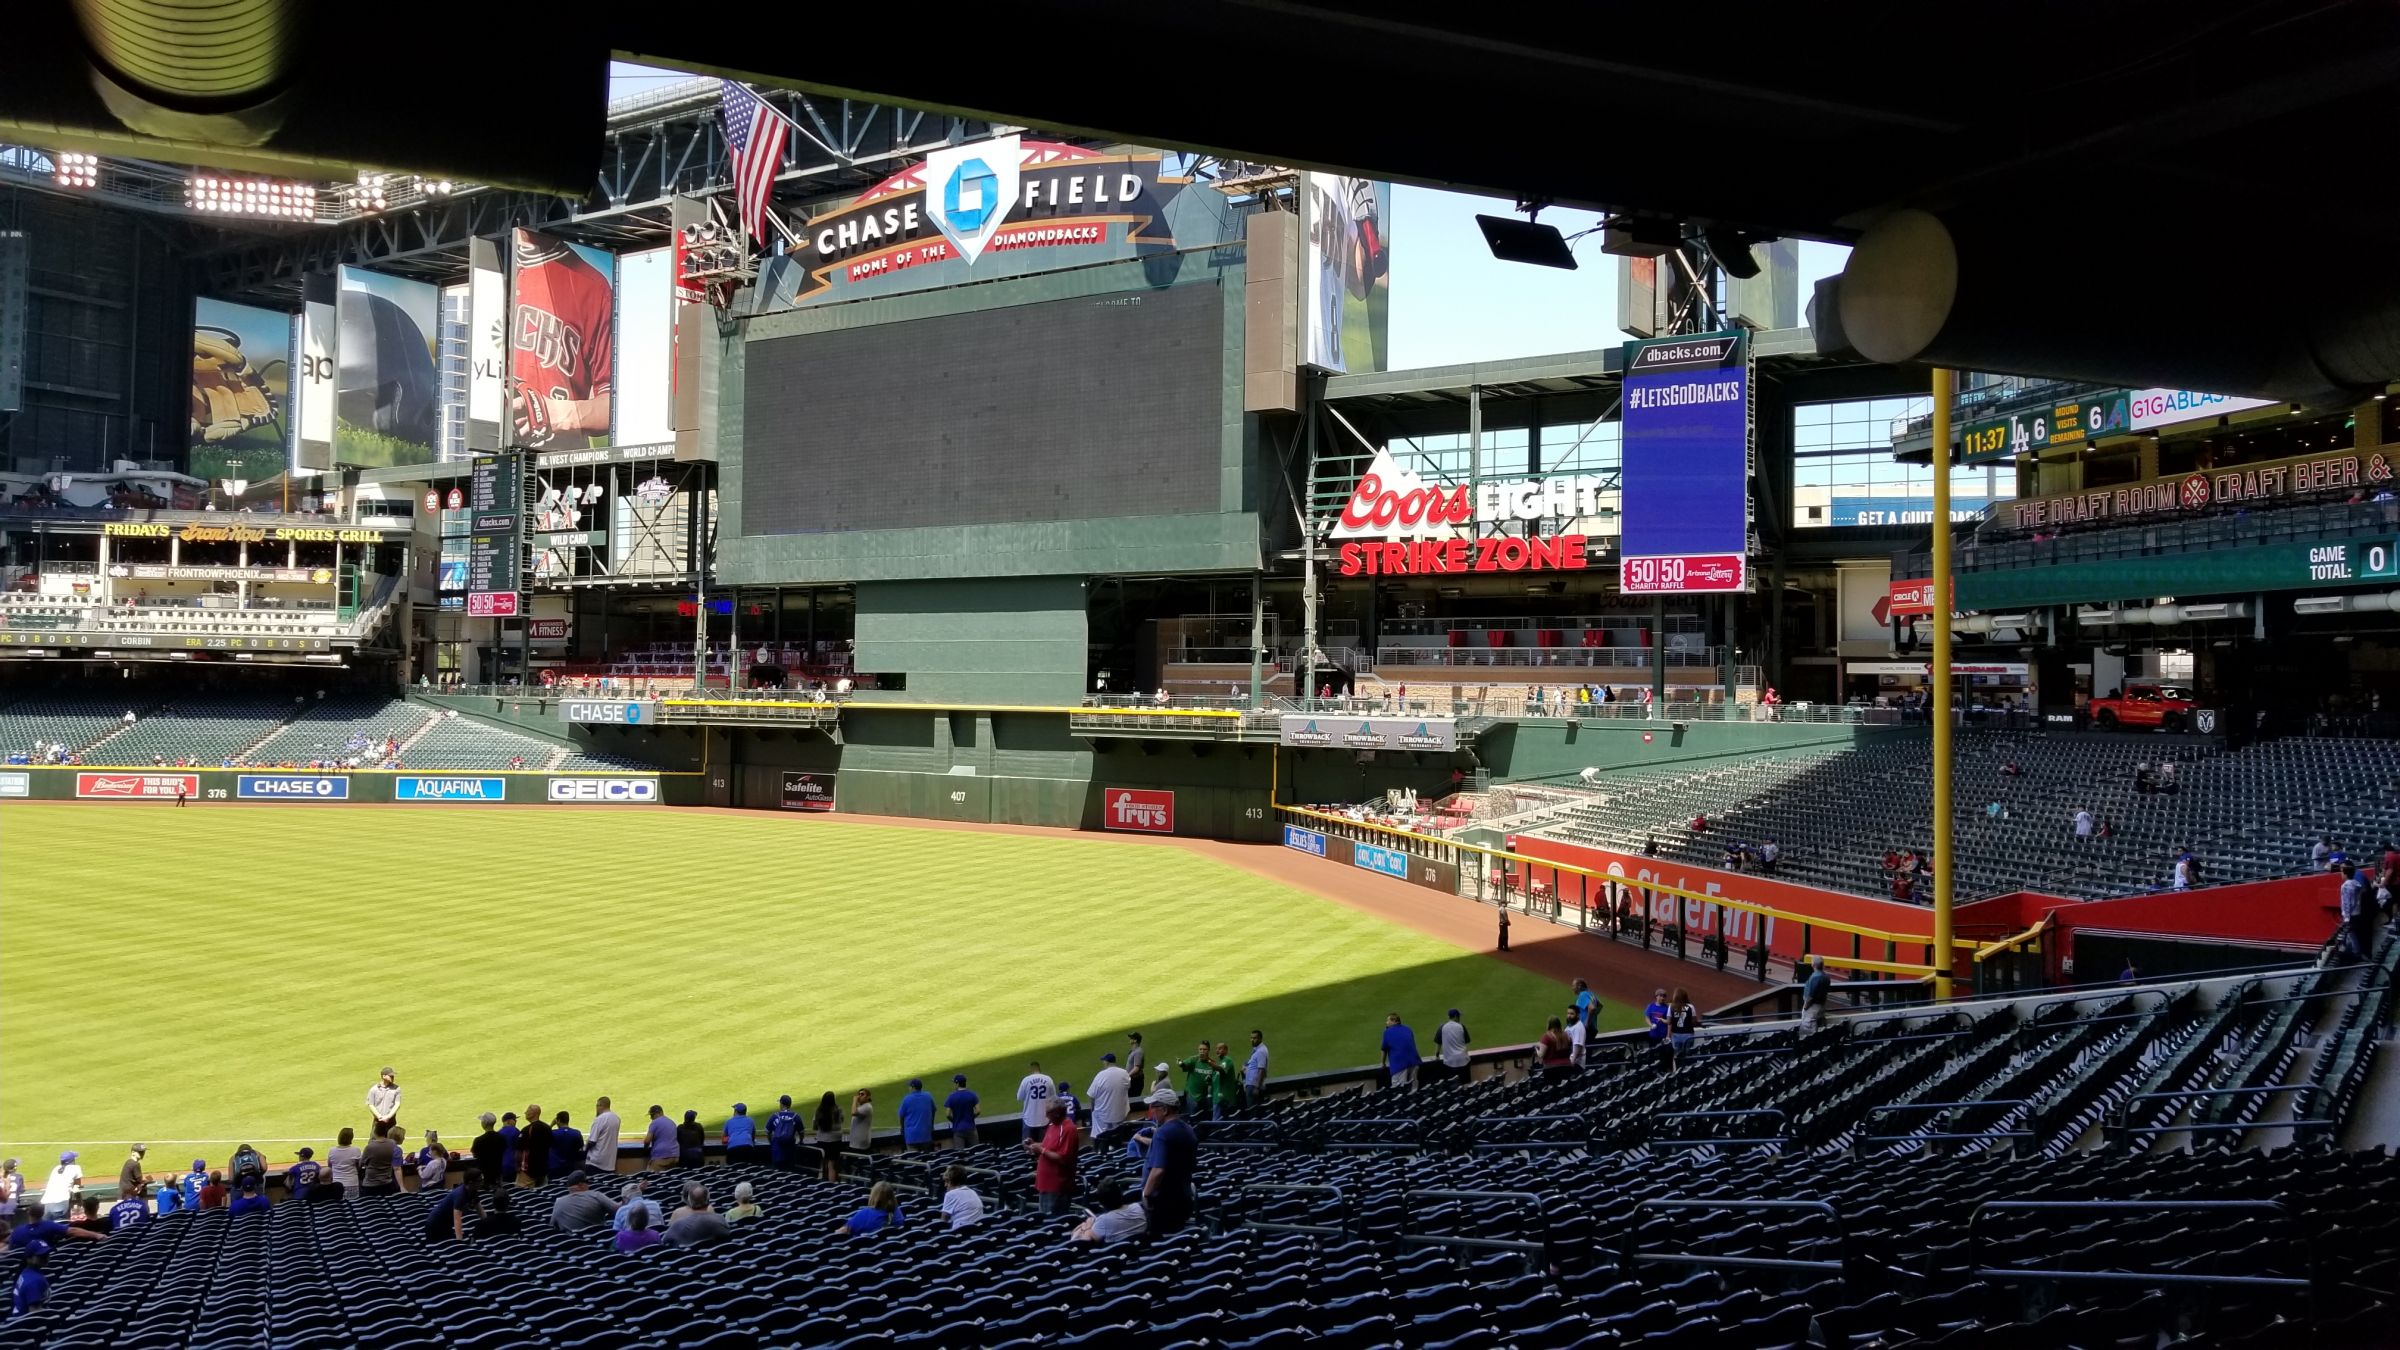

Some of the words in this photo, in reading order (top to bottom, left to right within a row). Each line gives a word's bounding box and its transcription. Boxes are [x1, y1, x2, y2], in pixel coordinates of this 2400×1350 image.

[817, 203, 919, 256] CHASE
[1024, 173, 1144, 209] FIELD
[853, 259, 889, 278] HOME
[896, 251, 912, 266] OF
[921, 244, 946, 259] THE
[994, 226, 1099, 247] DIAMONDBACKS
[1647, 345, 1721, 362] dbacks.com
[1629, 381, 1739, 409] #LETSGODBACKS
[2055, 404, 2079, 418] MOUND
[2132, 390, 2233, 418] G1GABLAS
[2056, 418, 2078, 430] VISITS
[2090, 405, 2102, 430] 6
[1965, 426, 2006, 455] 11:37
[2010, 415, 2029, 453] LA
[2034, 418, 2045, 441] 6
[2050, 429, 2085, 444] REMAINING
[539, 455, 548, 466] NL
[550, 453, 568, 465] WEST
[569, 450, 609, 463] CHAMPIONS
[623, 446, 647, 459] WORLD
[2013, 500, 2047, 528] THE
[2051, 492, 2112, 524] DRAFT
[2116, 483, 2176, 515] ROOM
[2215, 466, 2288, 504] CRAFT
[2294, 456, 2359, 493] BEER
[1341, 473, 1473, 529] Coors
[1476, 474, 1604, 522] LIGHT
[1858, 511, 1885, 526] GET
[1888, 511, 1897, 525] A
[104, 523, 170, 537] FRIDAY'S
[275, 528, 334, 542] SPORTS
[338, 529, 384, 543] GRILL
[550, 535, 568, 546] WILD
[569, 533, 588, 545] CARD
[1340, 538, 1469, 576] STRIKE
[1474, 534, 1588, 571] ZONE
[2309, 545, 2346, 563] GAME
[2369, 546, 2385, 572] 0
[168, 567, 275, 580] FRONTROWPHOENIX.com
[1705, 567, 1733, 583] Lottery
[2309, 563, 2352, 580] TOTAL:
[1630, 582, 1659, 590] CHARITY
[1660, 582, 1685, 590] RAFFLE
[539, 626, 563, 636] FITNESS
[20, 635, 26, 644] 0
[49, 635, 56, 644] 0
[81, 636, 87, 644] 0
[121, 636, 151, 645] CORBIN
[186, 638, 202, 646] ERA
[207, 638, 226, 647] 2.25
[230, 638, 242, 647] PC
[251, 638, 257, 647] 0
[283, 640, 289, 648] 0
[314, 640, 320, 648] 0
[571, 705, 624, 721] CHASE
[1290, 732, 1332, 741] THROWBACK
[1343, 734, 1386, 743] THROWBACK
[1399, 735, 1442, 744] THROWBACK
[142, 777, 160, 786] THIS
[253, 780, 314, 794] CHASE
[415, 778, 486, 798] AQUAFINA
[712, 778, 725, 789] 413
[785, 782, 823, 794] Safelite
[142, 786, 157, 795] FOR
[207, 788, 227, 799] 376
[550, 779, 650, 800] GEICO
[951, 791, 966, 802] 407
[805, 793, 833, 802] AutoGlass
[1112, 792, 1167, 827] fry's
[1245, 808, 1263, 819] 413
[1425, 867, 1436, 883] 376
[1030, 1085, 1047, 1100] 32
[300, 1171, 316, 1185] 22
[194, 1180, 202, 1192] 5
[119, 1209, 140, 1228] 22
